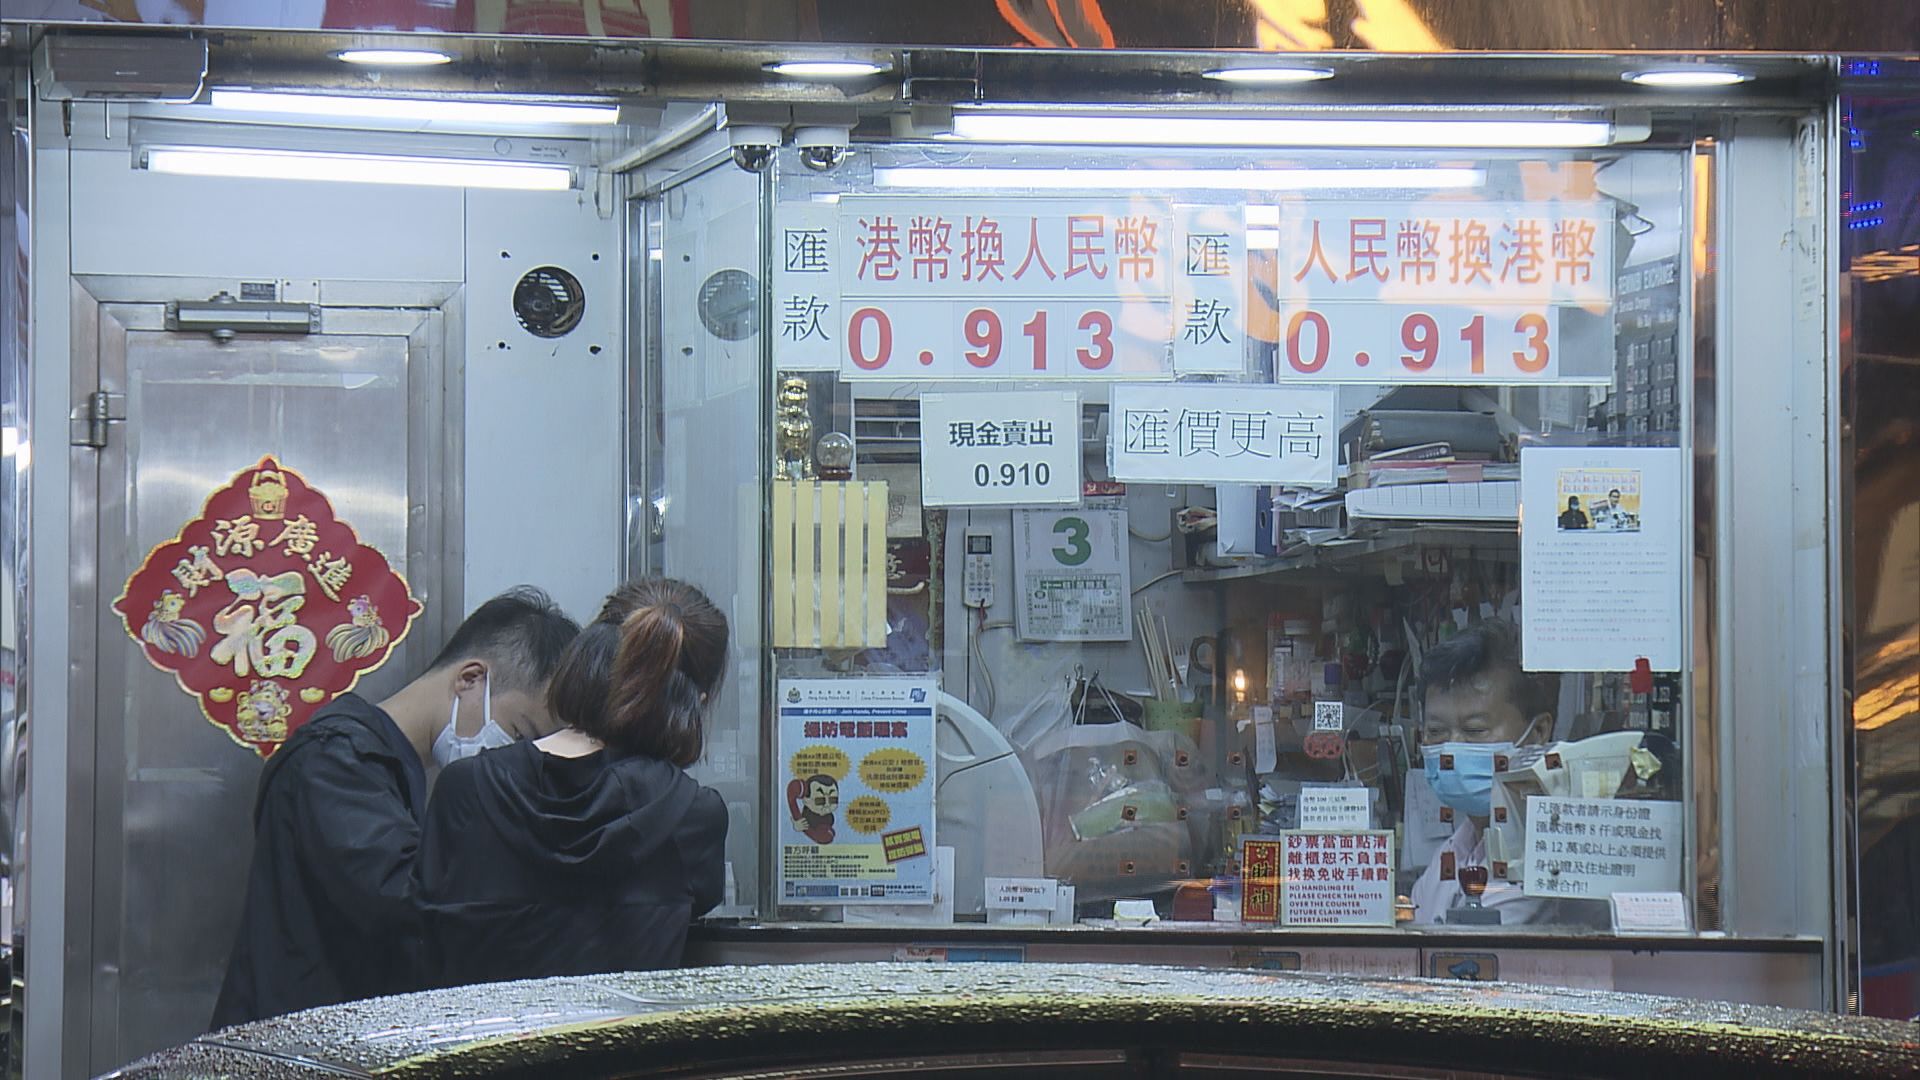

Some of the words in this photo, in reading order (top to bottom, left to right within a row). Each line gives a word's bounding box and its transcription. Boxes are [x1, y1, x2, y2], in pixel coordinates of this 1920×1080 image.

[856, 214, 1160, 283] 港幣換人民幣
[1294, 218, 1595, 286] 人民幣換港幣
[783, 227, 831, 343] 匯款
[1184, 230, 1231, 345] 匯款
[847, 305, 1115, 371] 0.913
[1286, 310, 1551, 375] 0.913
[948, 419, 1055, 448] 現金賣出
[1123, 406, 1325, 460] 匯價更高
[974, 461, 1051, 488] 0.910
[1051, 516, 1092, 567] 3
[210, 567, 318, 679] 福
[1288, 835, 1388, 849] 鈔票當面點清
[1288, 852, 1388, 865] 離櫃恕不負責
[1288, 868, 1389, 881] 找換免收手續費
